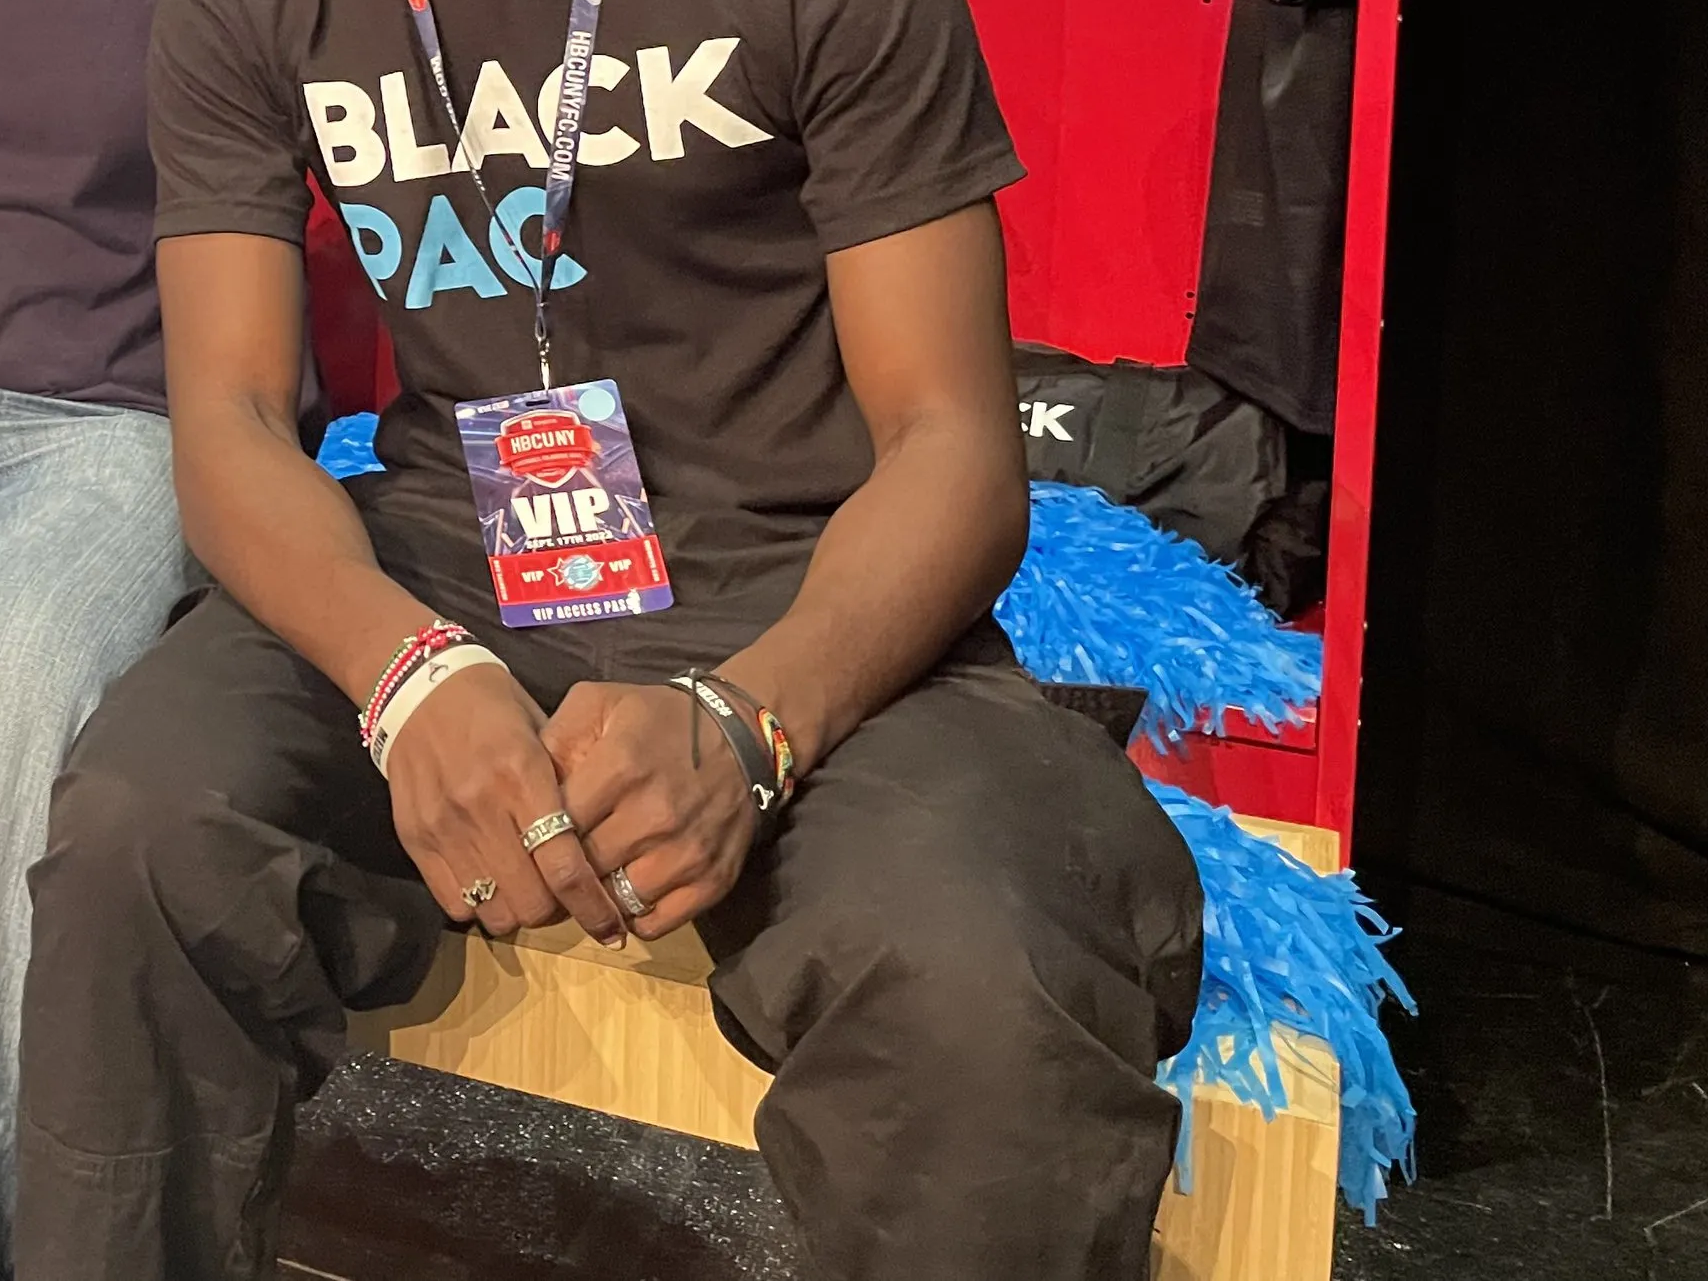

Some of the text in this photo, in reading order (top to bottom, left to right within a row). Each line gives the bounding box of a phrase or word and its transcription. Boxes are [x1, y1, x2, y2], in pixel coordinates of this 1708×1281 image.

[303, 37, 776, 187] BLACK
[339, 185, 588, 310] PAC
[511, 488, 610, 539] VIP
[521, 558, 632, 583] VIP VIP
[532, 607, 554, 621] VIP
[556, 603, 602, 619] ACCESS
